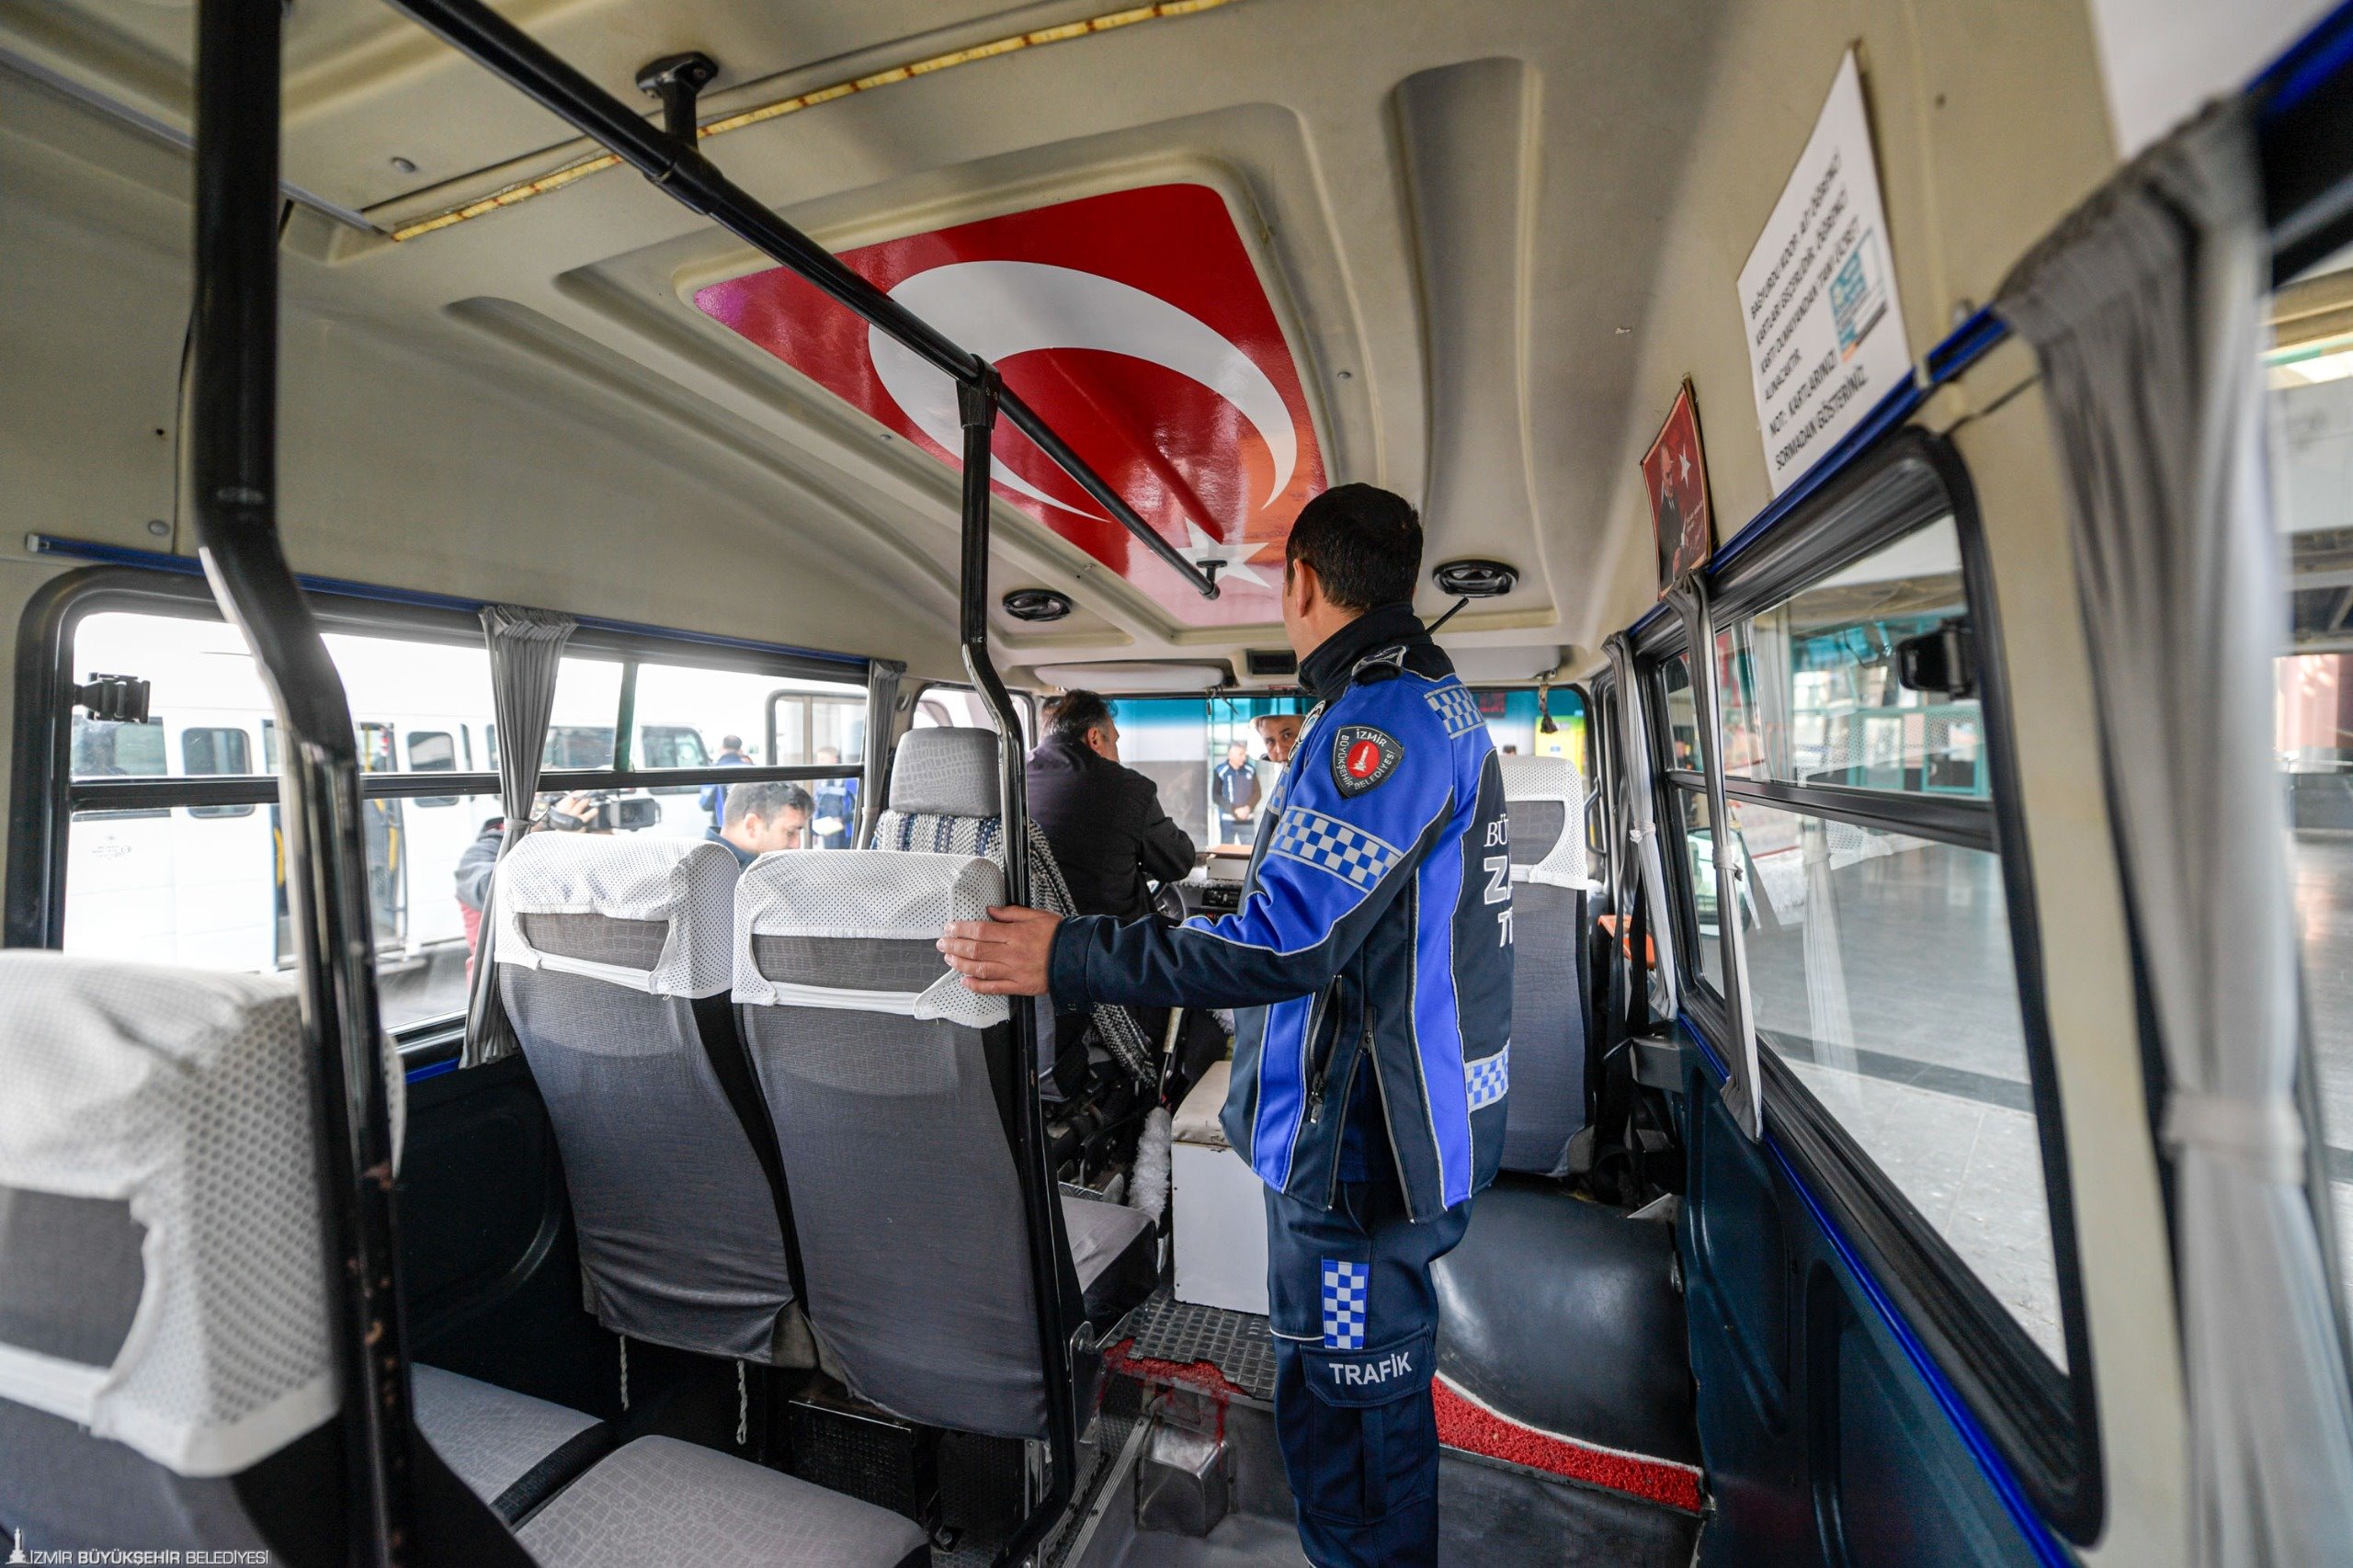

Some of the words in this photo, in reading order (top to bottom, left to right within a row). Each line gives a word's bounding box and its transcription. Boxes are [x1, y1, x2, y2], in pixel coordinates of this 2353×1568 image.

[1775, 418, 1817, 471] SORMADAN
[1356, 728, 1387, 747] İZMİR
[1336, 734, 1354, 788] BÜYÜKŞEHİR
[1354, 749, 1396, 790] BELEDİYESİ
[1329, 1351, 1413, 1386] TRAFİK
